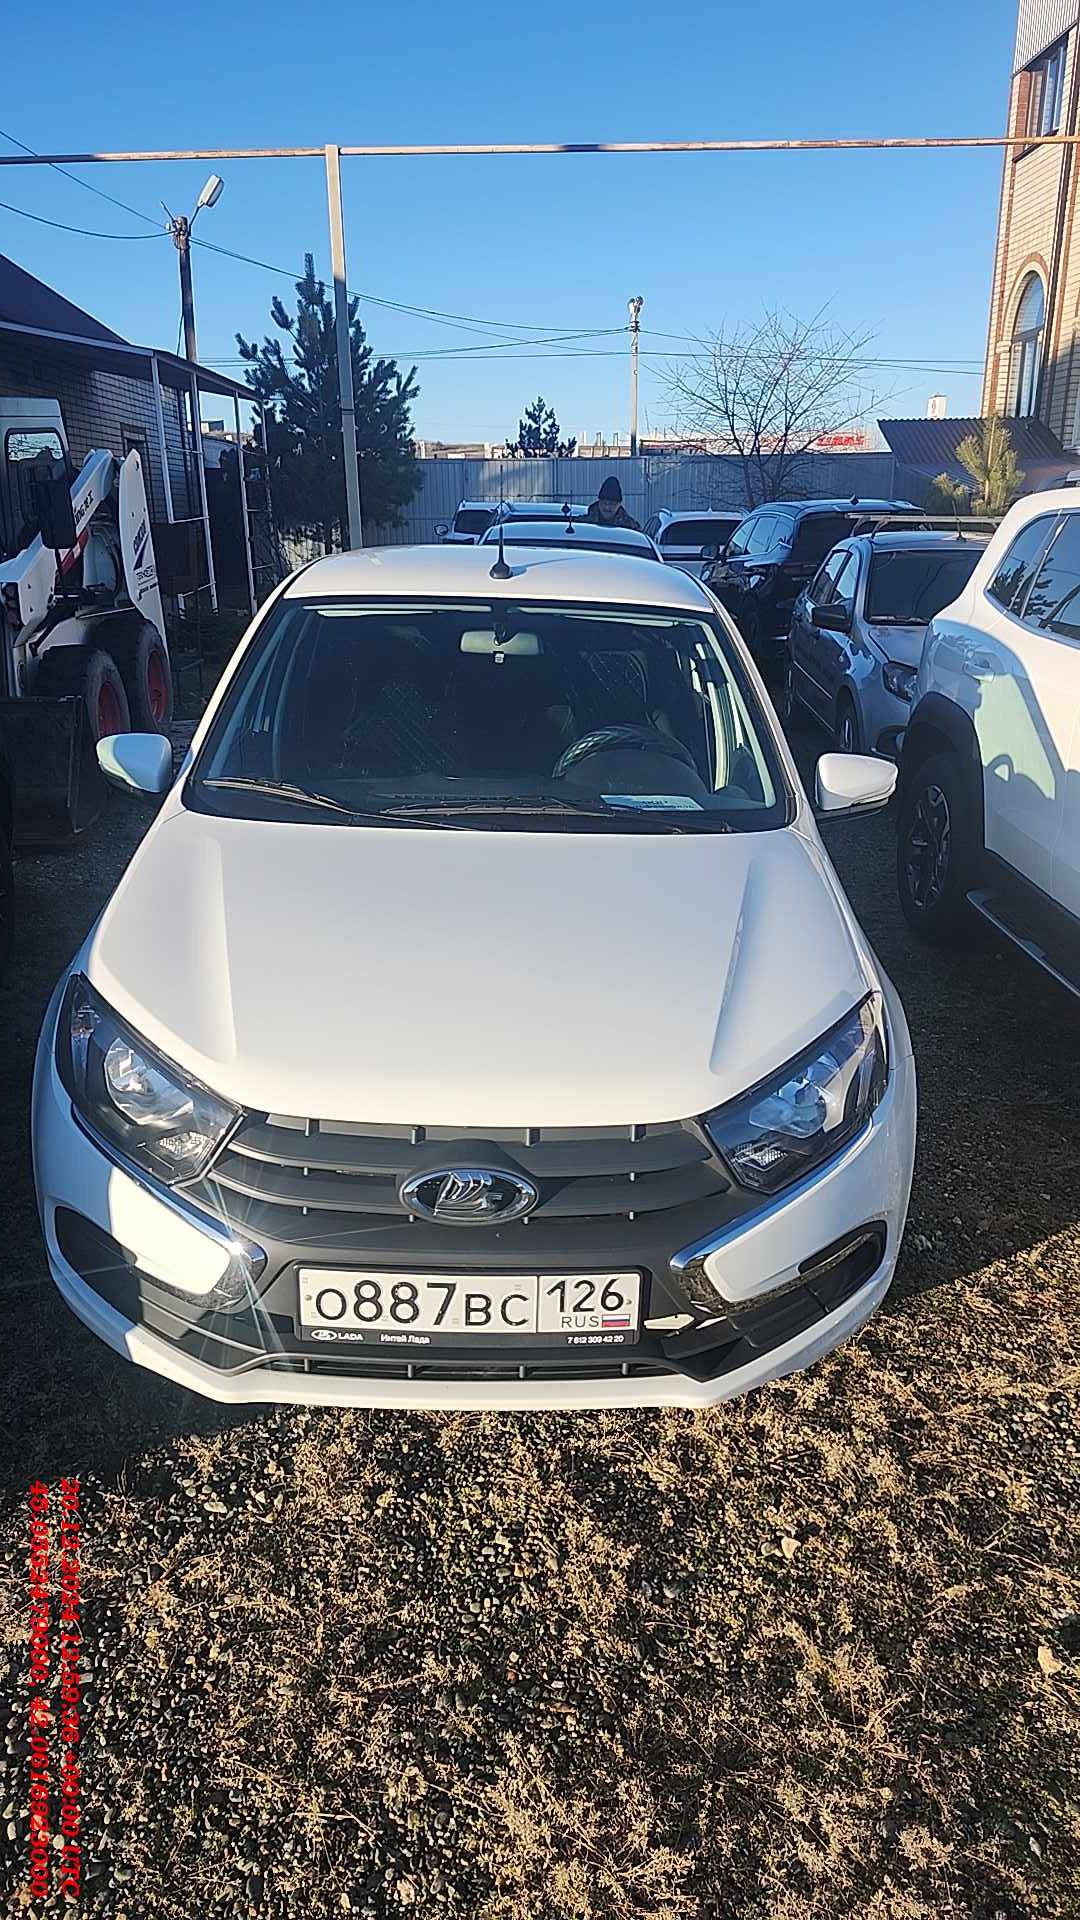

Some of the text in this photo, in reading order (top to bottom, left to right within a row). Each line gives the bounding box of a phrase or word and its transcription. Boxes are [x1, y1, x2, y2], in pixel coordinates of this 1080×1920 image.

[546, 1278, 625, 1313] 126
[561, 1316, 600, 1329] RUS
[338, 1332, 364, 1341] LADA
[408, 1335, 431, 1345] Лада
[603, 1335, 613, 1343] 42
[613, 1334, 625, 1343] 20
